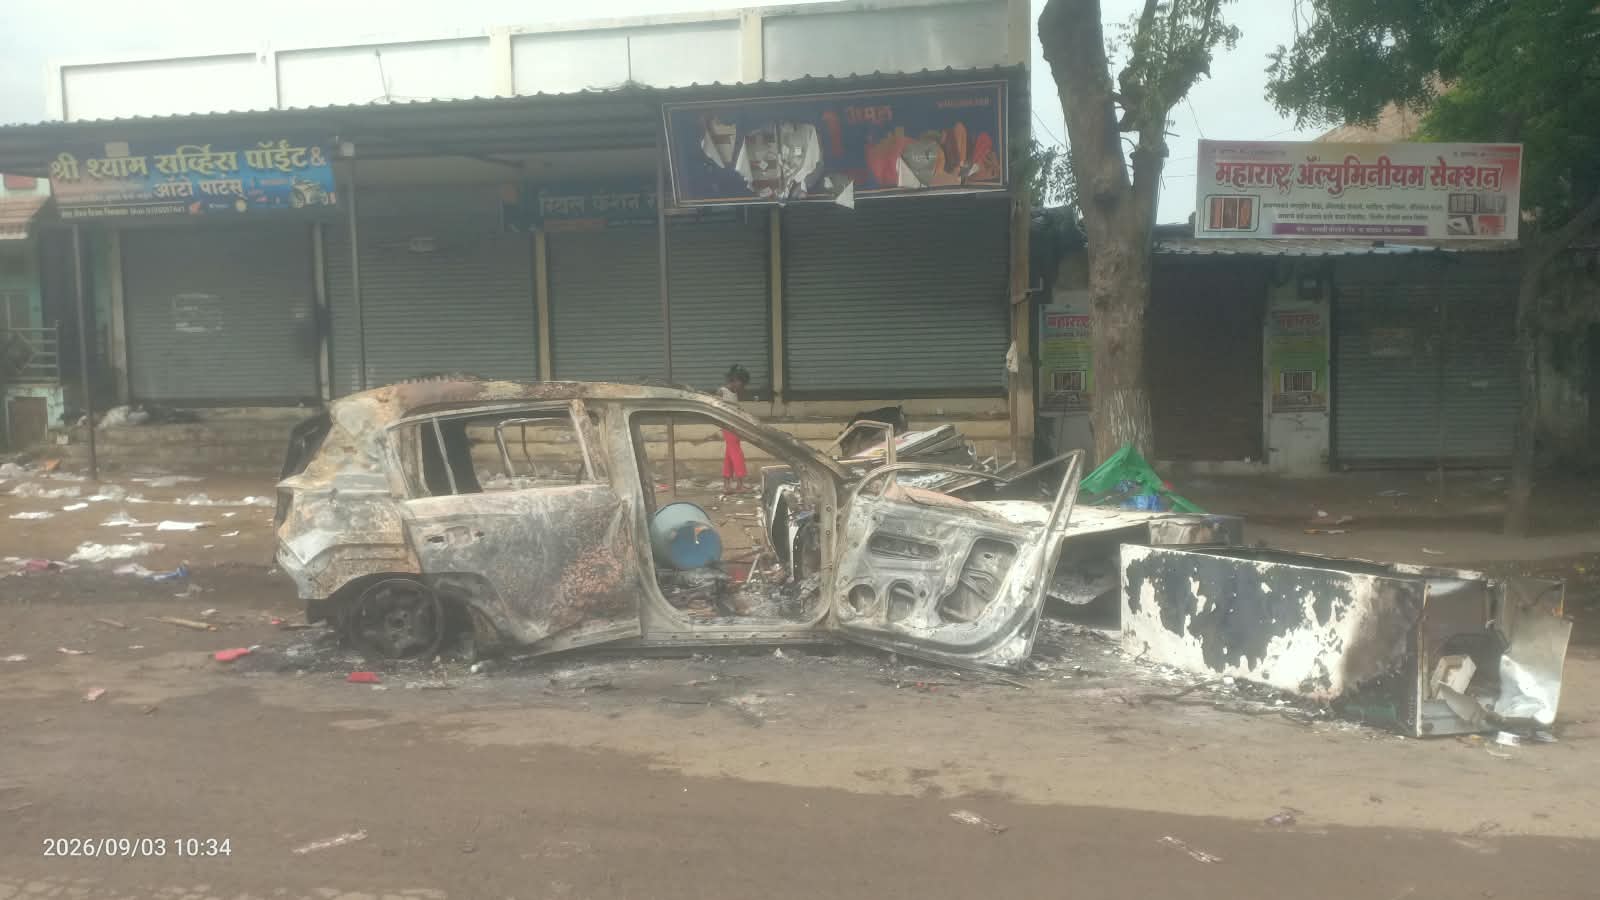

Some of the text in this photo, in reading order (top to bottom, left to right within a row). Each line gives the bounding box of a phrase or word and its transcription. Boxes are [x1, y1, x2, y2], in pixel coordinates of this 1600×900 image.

[50, 152, 79, 179] श्री
[87, 156, 148, 178] श्याम
[310, 146, 326, 166] &
[1215, 161, 1294, 194] महाराष्ट्र
[1430, 156, 1503, 190] सेक्शन
